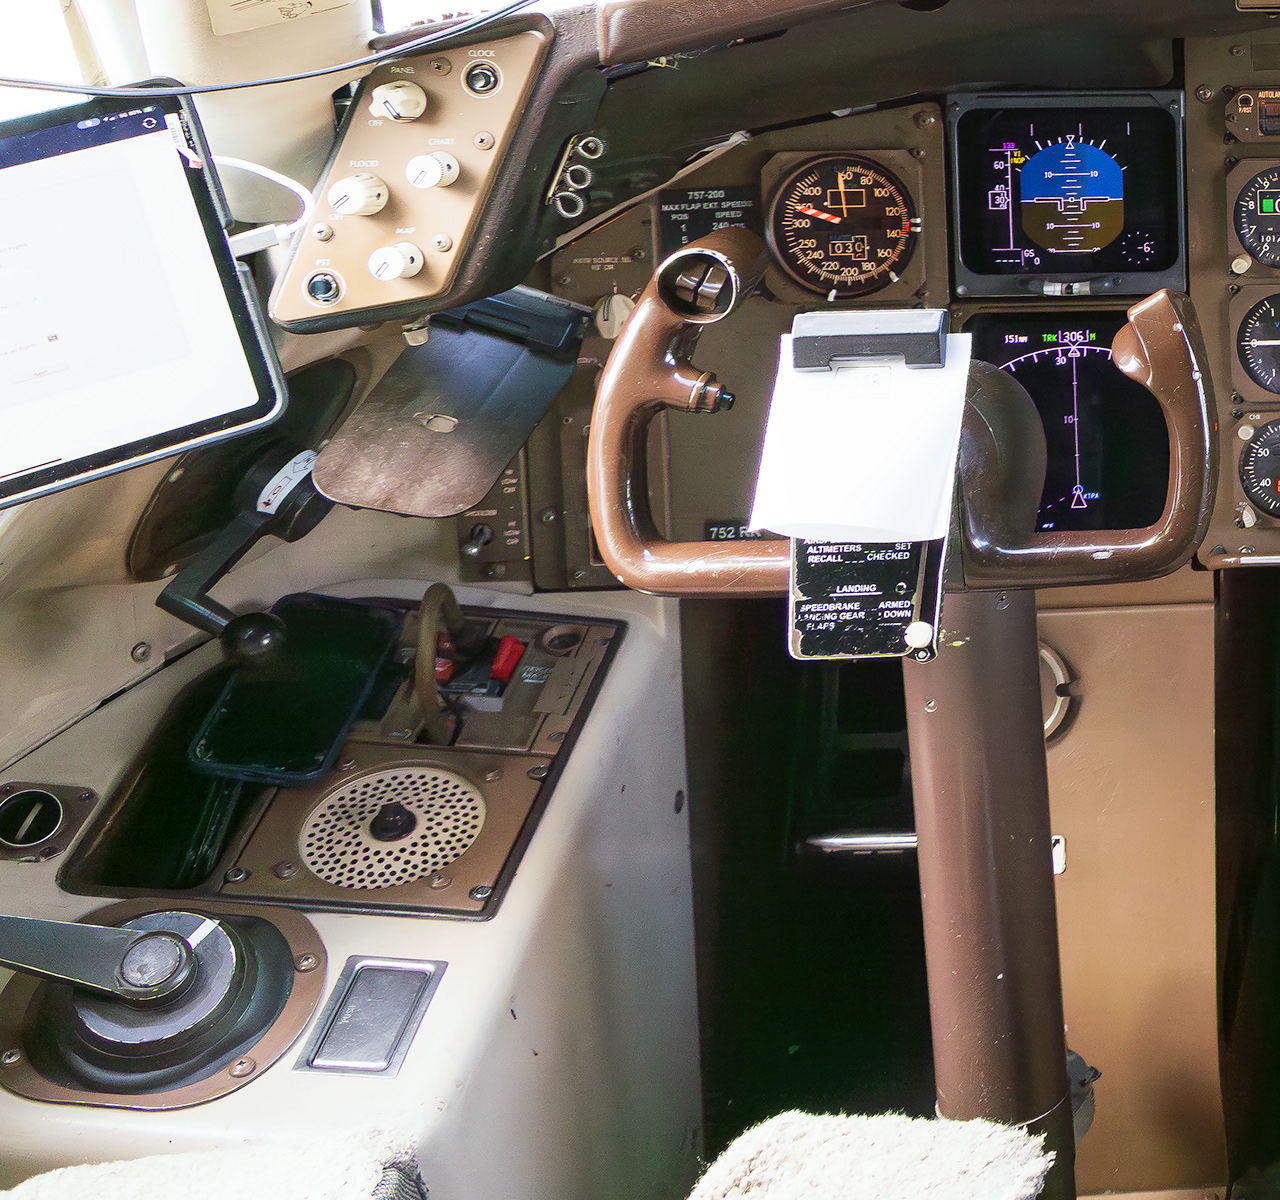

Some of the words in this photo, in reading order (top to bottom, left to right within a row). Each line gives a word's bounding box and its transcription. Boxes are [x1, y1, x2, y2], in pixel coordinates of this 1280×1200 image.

[807, 545, 862, 554] ALTIMETERS
[895, 542, 912, 550] SET
[808, 555, 843, 563] RECALL
[867, 552, 910, 560] CHECKED
[836, 585, 877, 593] LANDING
[800, 603, 860, 612] SPEEDBRAKE
[879, 601, 911, 609] ARMED
[839, 612, 865, 620] GEAR
[883, 610, 911, 618] DOWN
